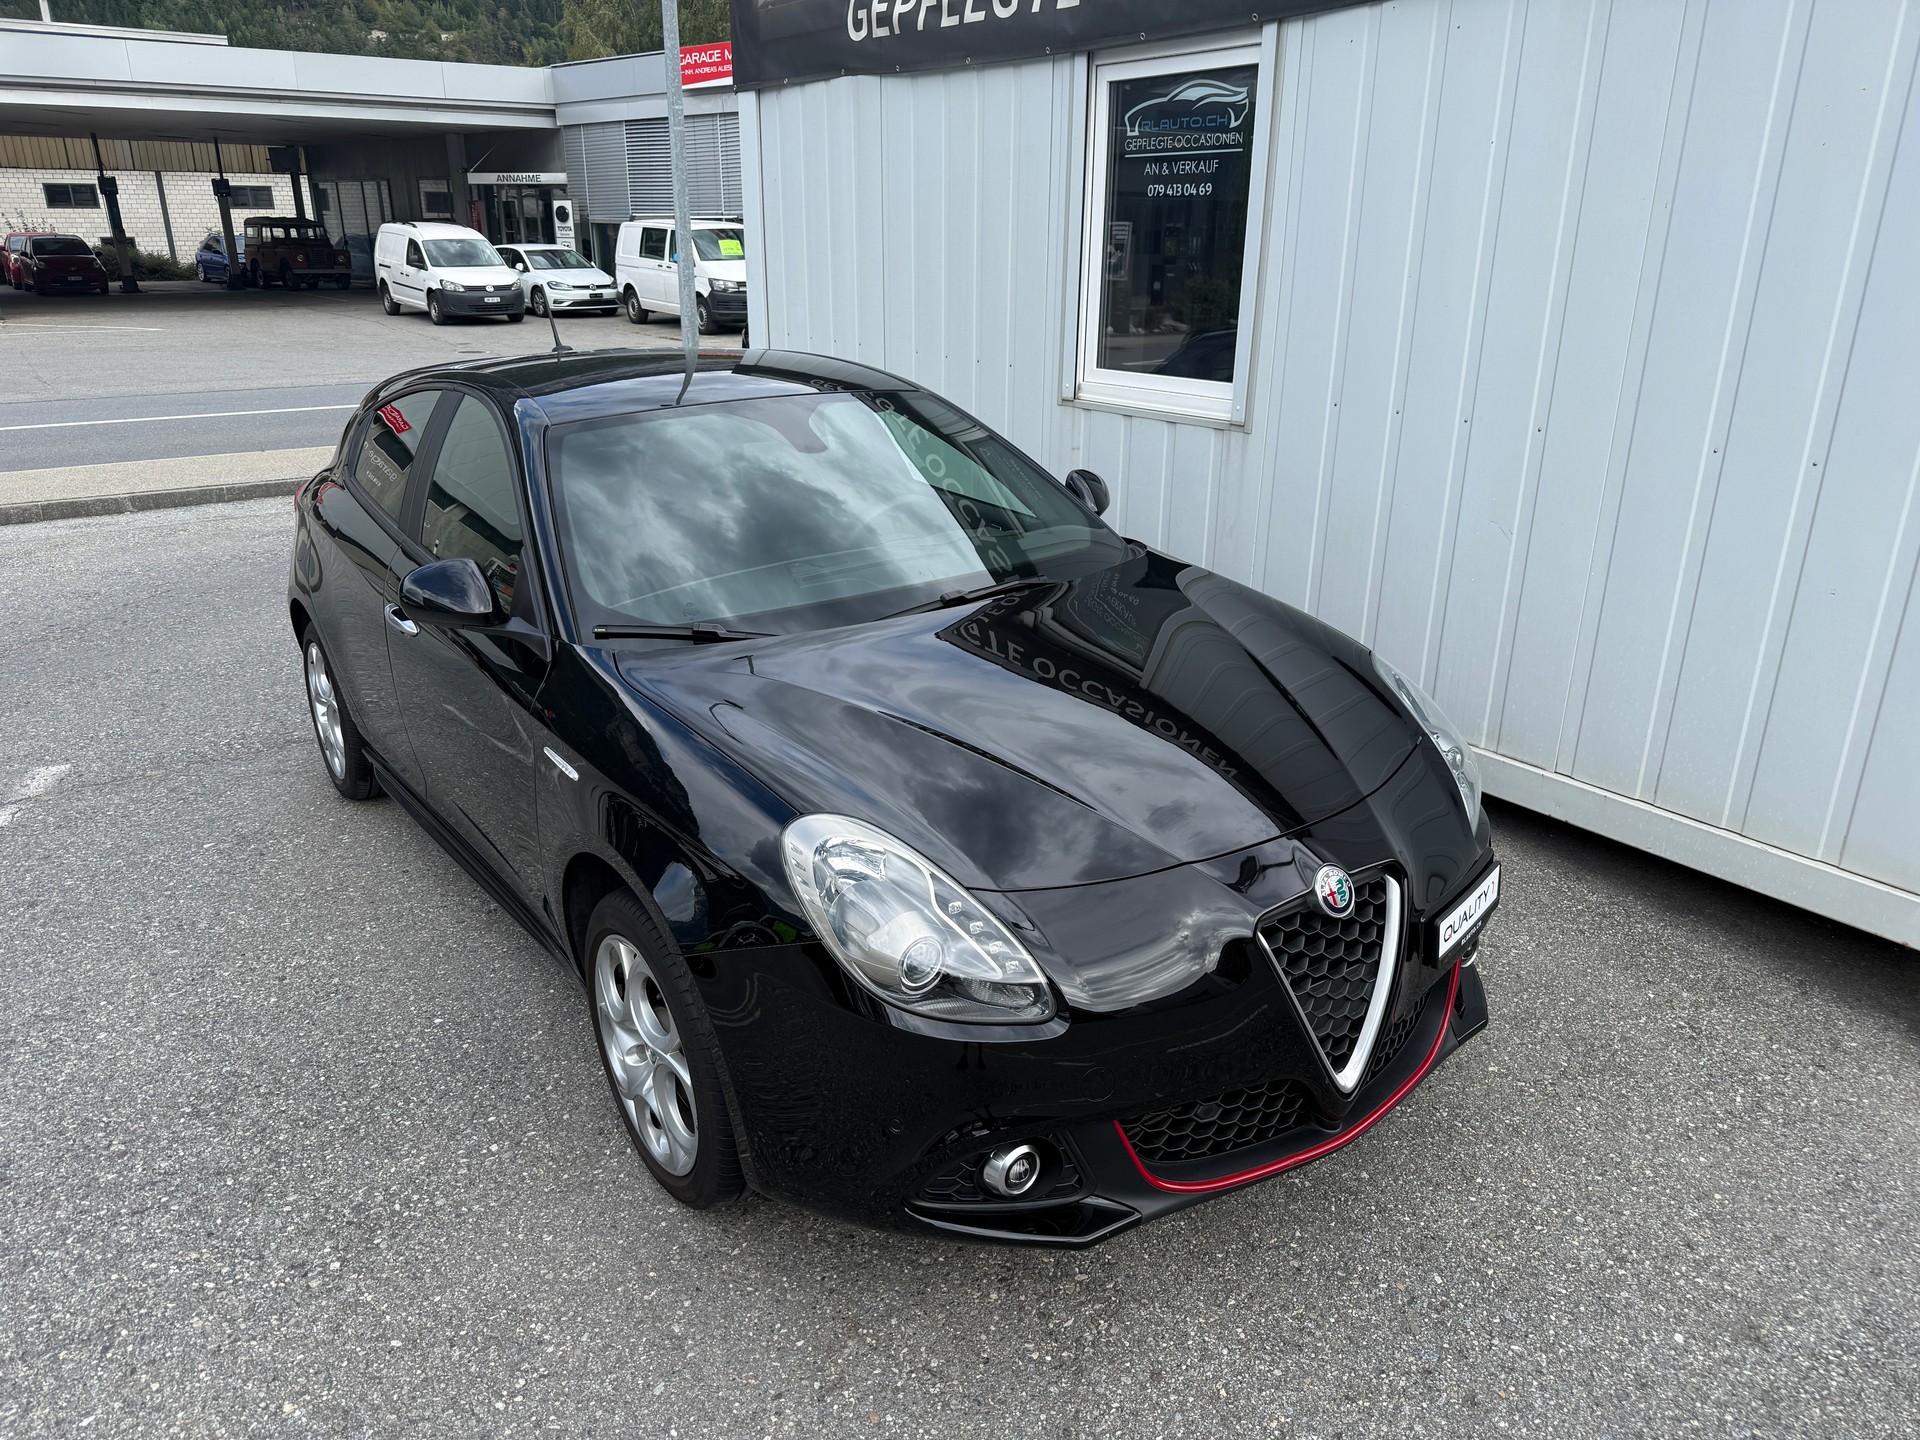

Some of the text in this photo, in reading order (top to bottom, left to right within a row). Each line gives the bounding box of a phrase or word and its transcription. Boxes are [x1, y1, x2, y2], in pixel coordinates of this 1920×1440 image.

[847, 0, 1080, 41] GEPFL
[680, 50, 721, 65] GARAGE
[1124, 132, 1243, 151] GEPFLEGTE OCCASIONEN
[1144, 160, 1219, 175] AN & VERKAUF
[496, 174, 542, 183] ANNAHME
[1147, 182, 1213, 197] 079 413 04 69
